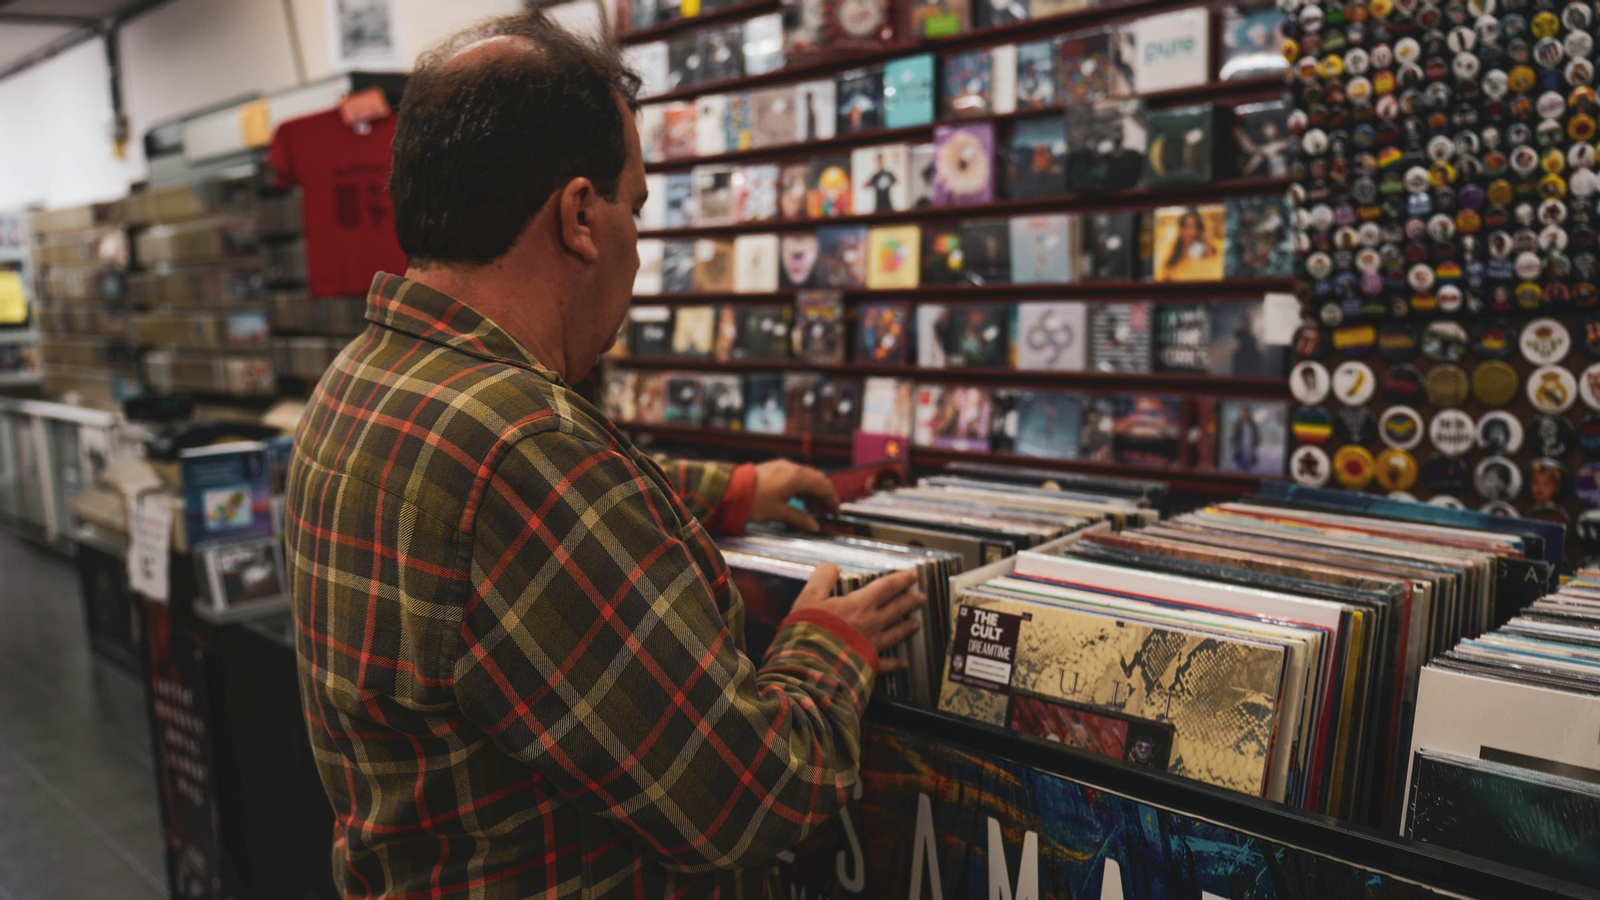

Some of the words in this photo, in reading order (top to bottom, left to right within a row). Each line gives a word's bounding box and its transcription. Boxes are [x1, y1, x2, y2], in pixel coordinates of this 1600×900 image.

[1144, 37, 1195, 66] pure
[973, 609, 1000, 627] THE
[970, 623, 1004, 641] CULT
[967, 639, 1012, 660] DREAMTIME
